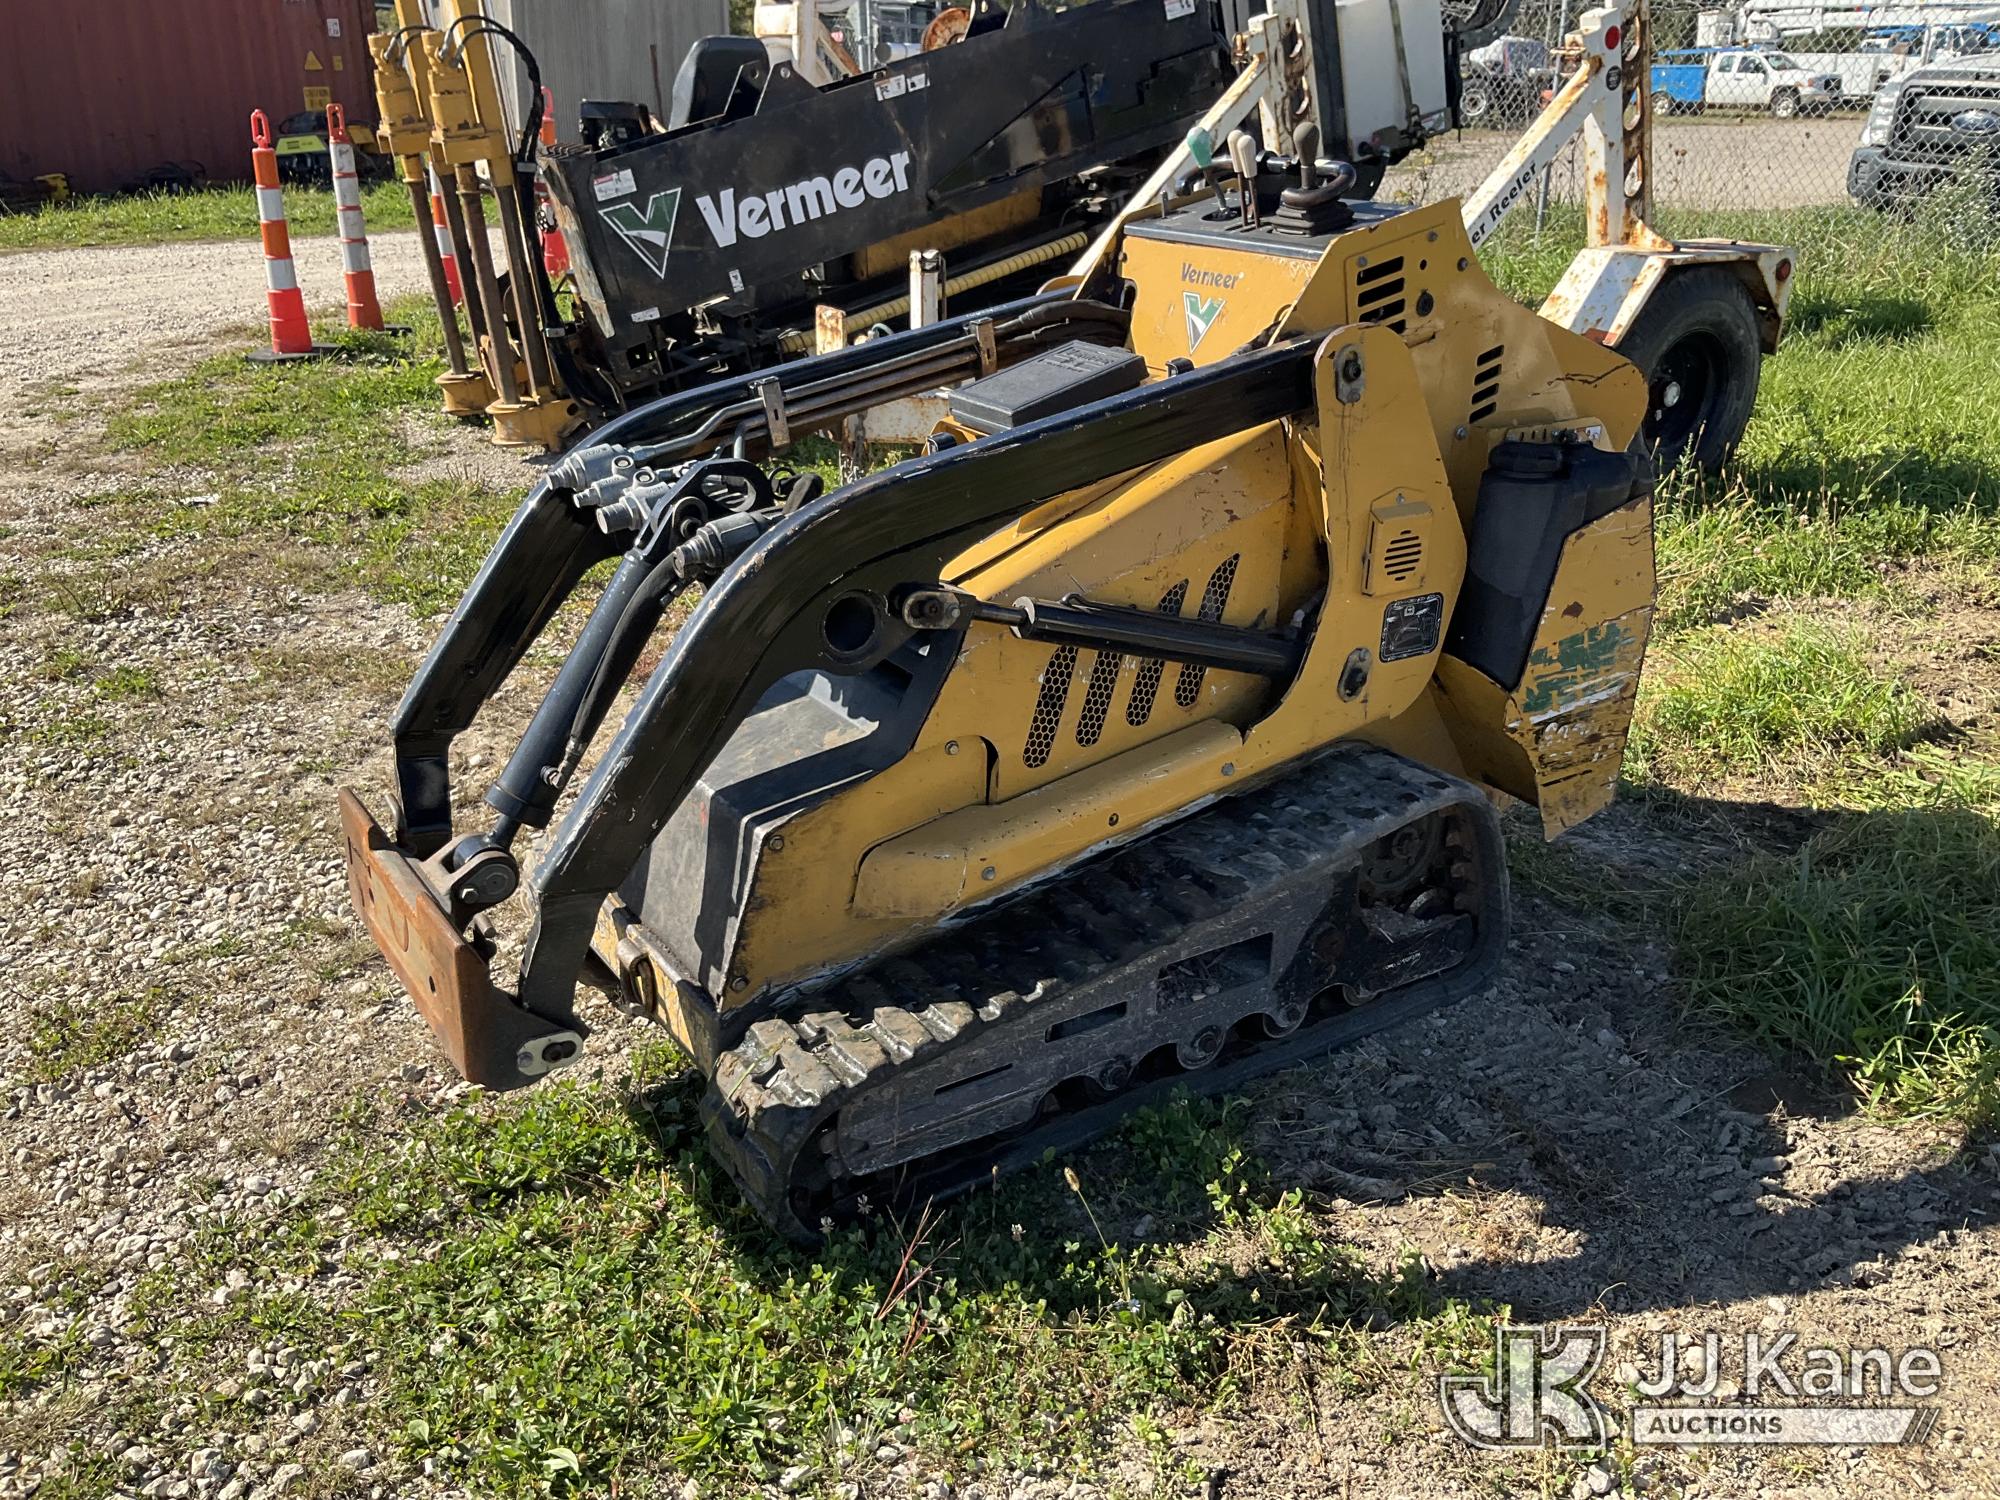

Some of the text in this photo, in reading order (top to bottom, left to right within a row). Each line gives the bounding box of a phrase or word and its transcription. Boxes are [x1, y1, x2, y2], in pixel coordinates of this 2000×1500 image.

[696, 151, 910, 248] Vermeer
[1489, 159, 1538, 222] Reeler
[1181, 262, 1239, 290] Vermeer
